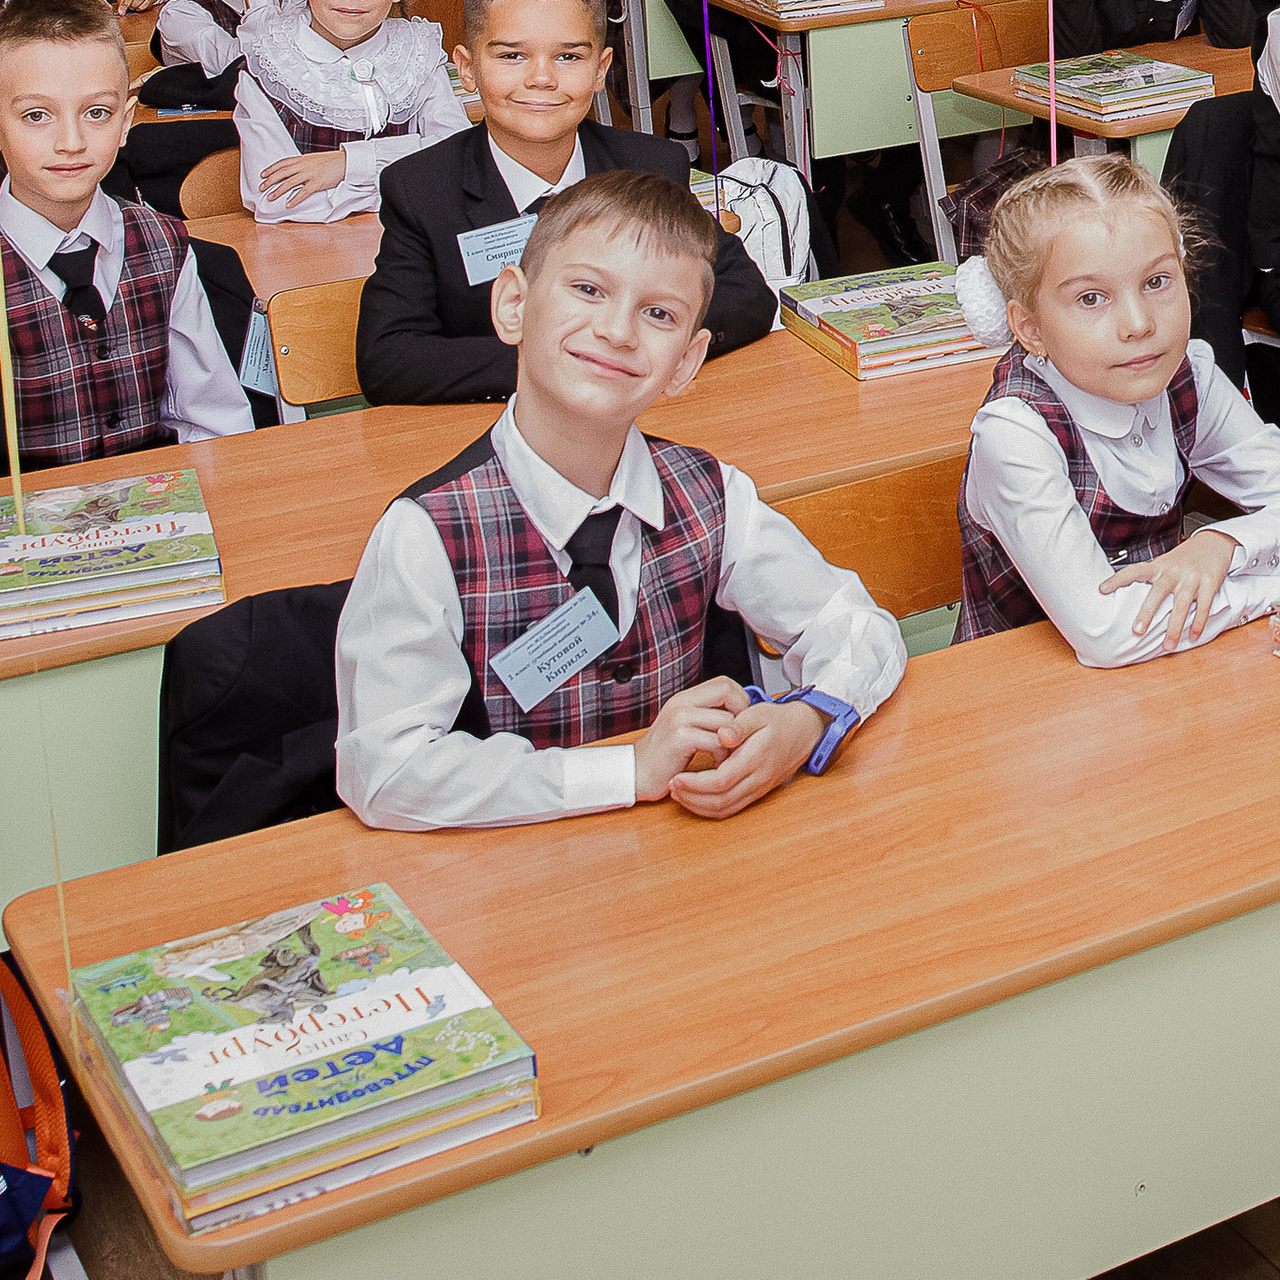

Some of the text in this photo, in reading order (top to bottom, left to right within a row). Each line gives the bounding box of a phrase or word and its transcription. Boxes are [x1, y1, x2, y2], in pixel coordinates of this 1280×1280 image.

[536, 636, 583, 675] Кутовой
[545, 647, 588, 683] Кирилл
[204, 987, 431, 1067] Петербург
